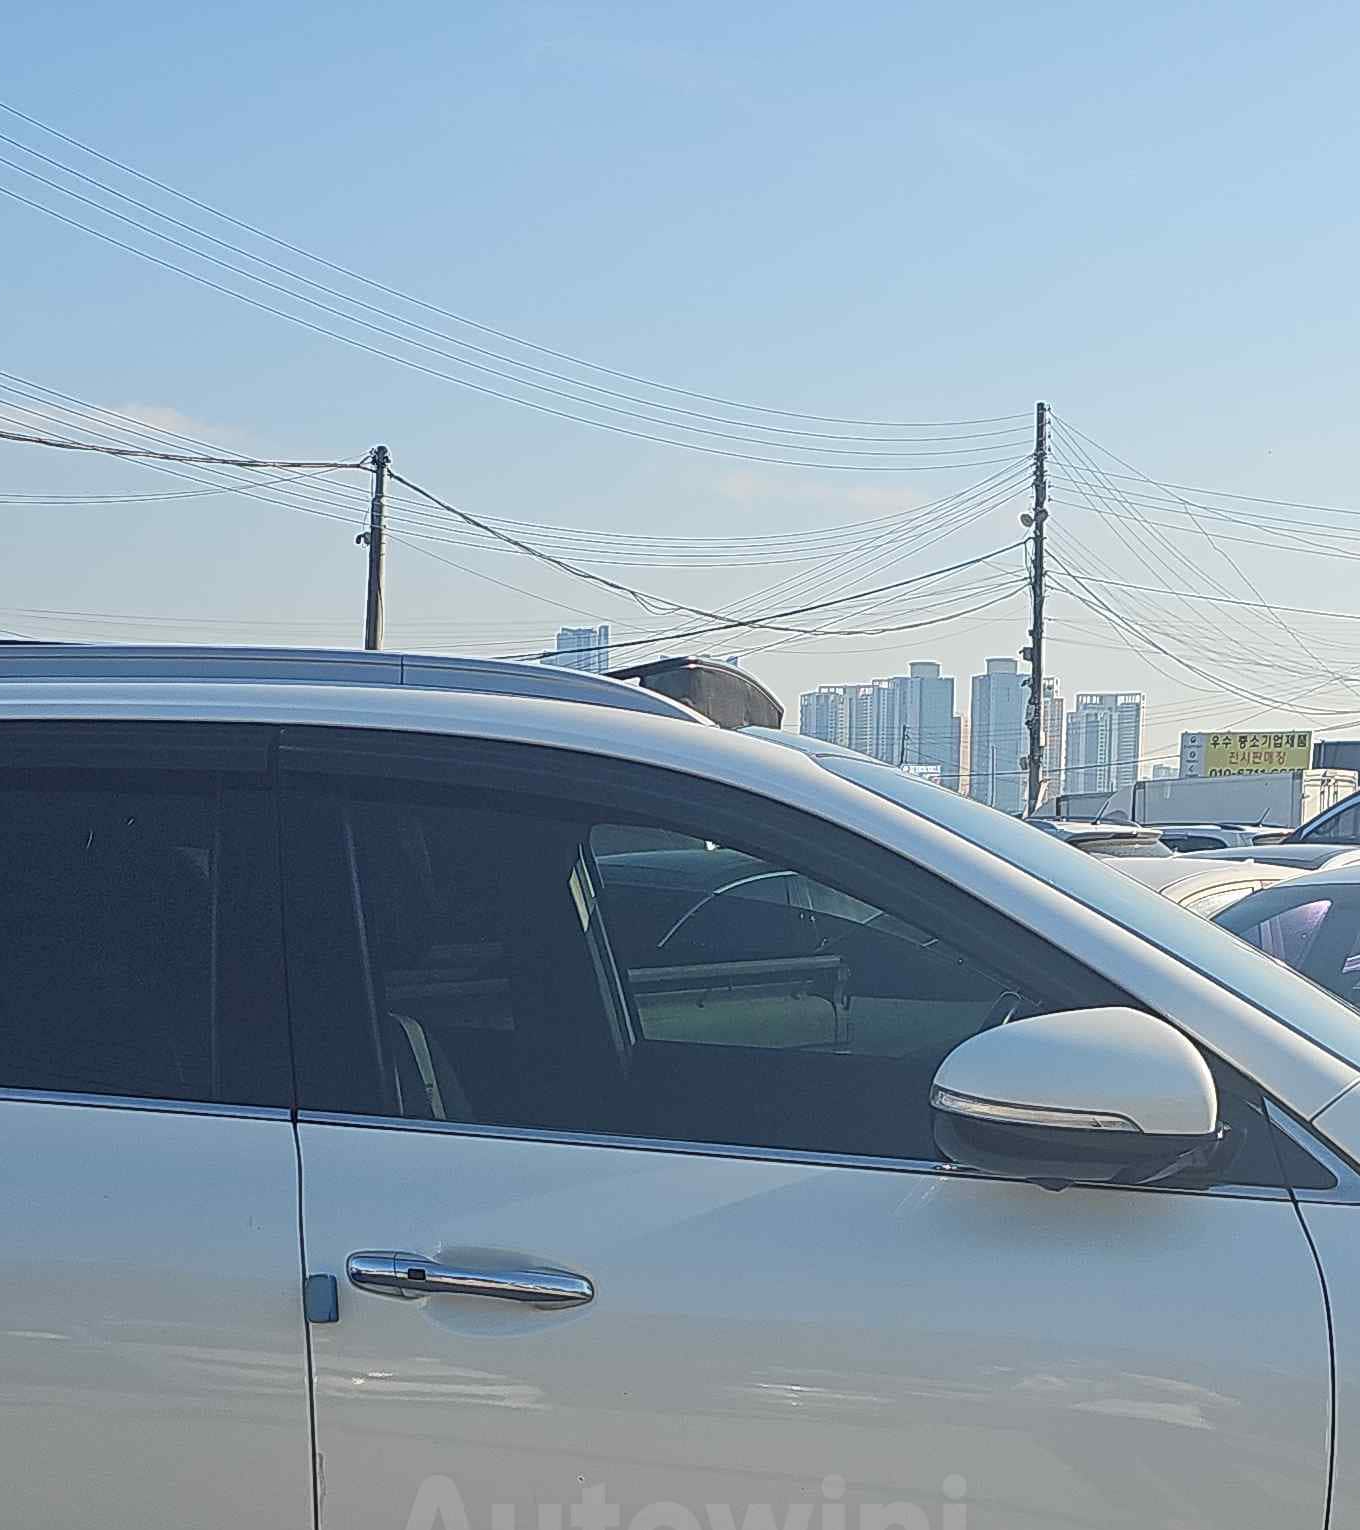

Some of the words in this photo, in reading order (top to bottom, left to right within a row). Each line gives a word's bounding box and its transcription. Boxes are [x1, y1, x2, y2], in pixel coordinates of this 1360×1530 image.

[1210, 735, 1232, 749] 우수
[1238, 734, 1308, 749] 중소기업제품
[1229, 750, 1287, 765] 전시판매장
